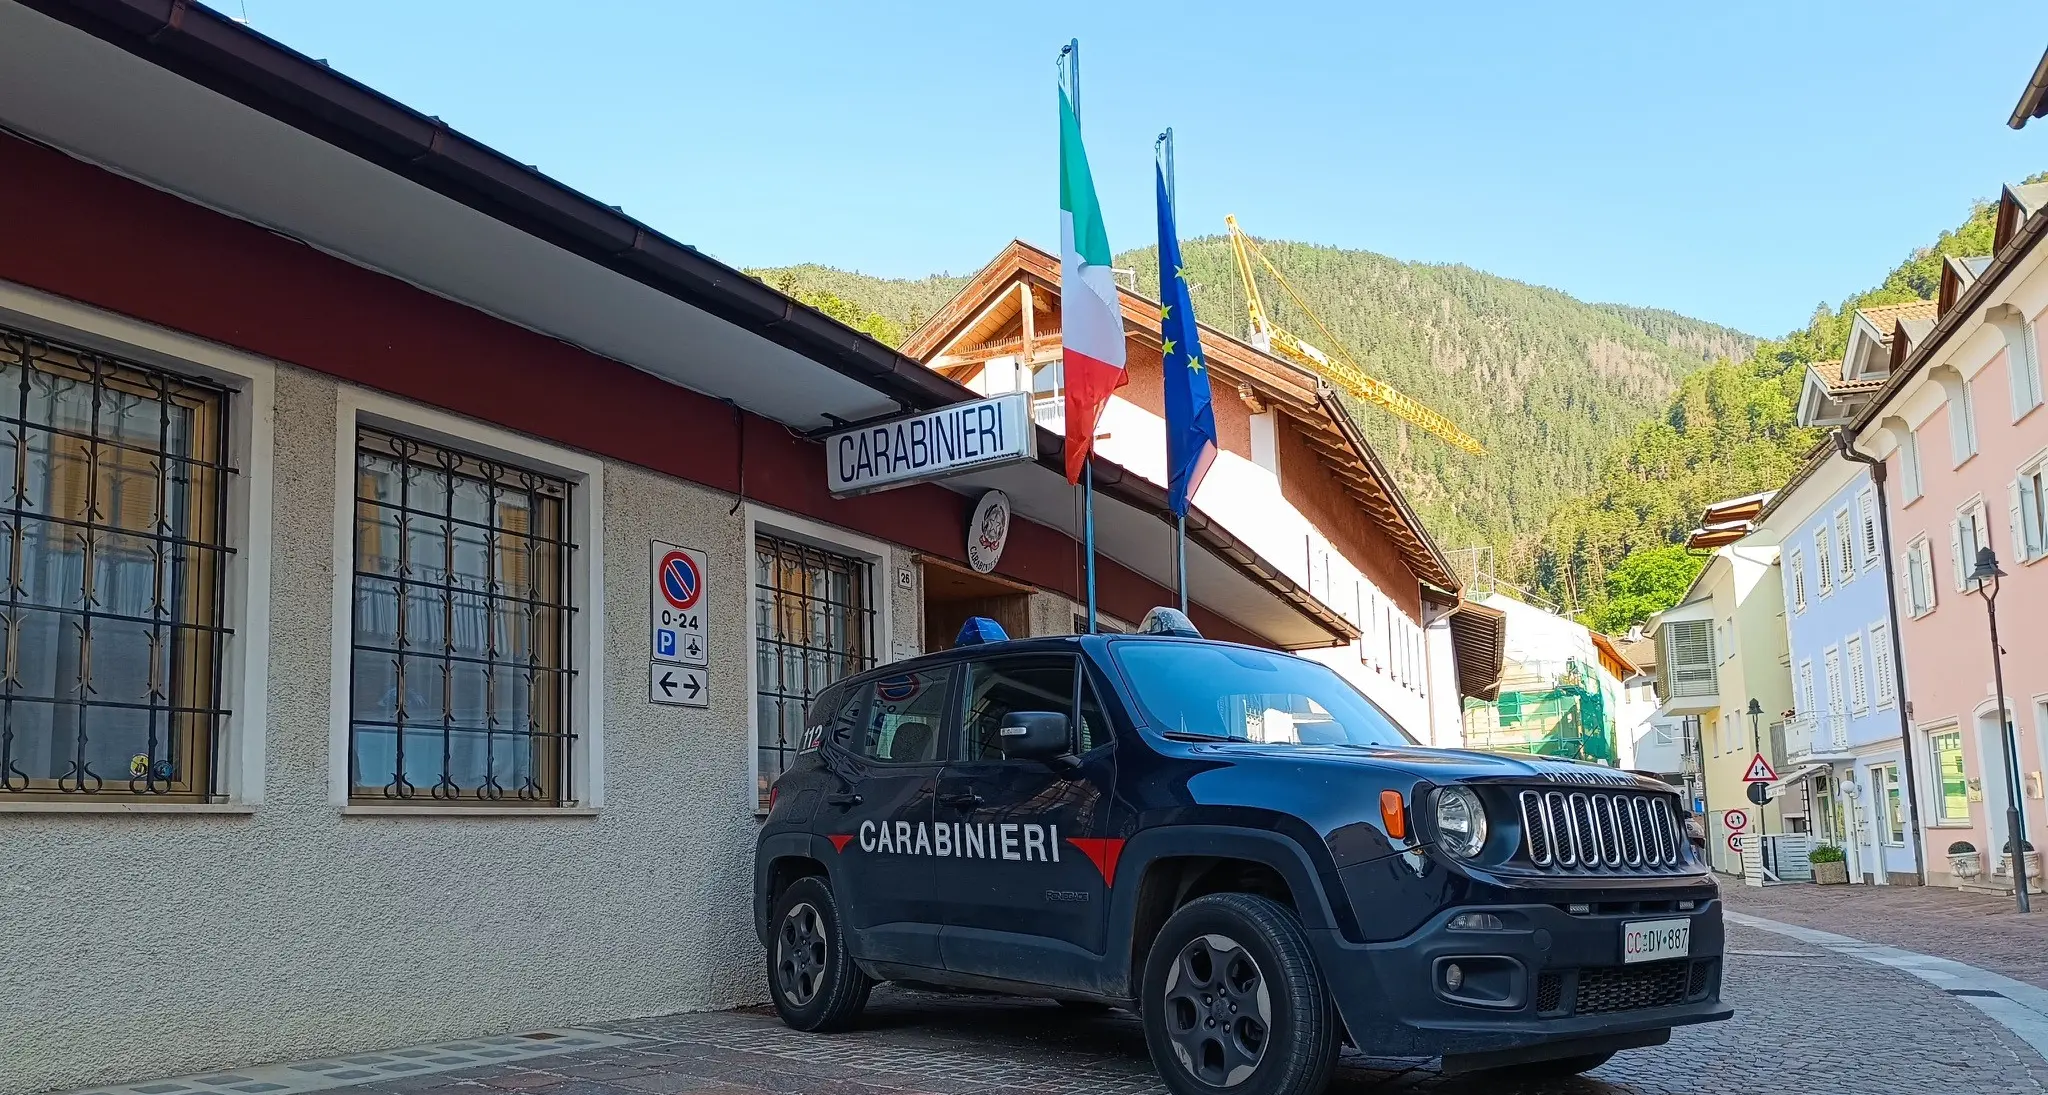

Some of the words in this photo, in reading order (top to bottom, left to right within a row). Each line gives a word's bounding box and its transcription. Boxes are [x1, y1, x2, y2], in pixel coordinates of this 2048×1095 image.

[838, 402, 1004, 483] CARABINIERI
[901, 573, 910, 584] 26
[661, 610, 699, 631] 0-24
[802, 724, 823, 749] 112
[859, 819, 1060, 862] CARABINIERI
